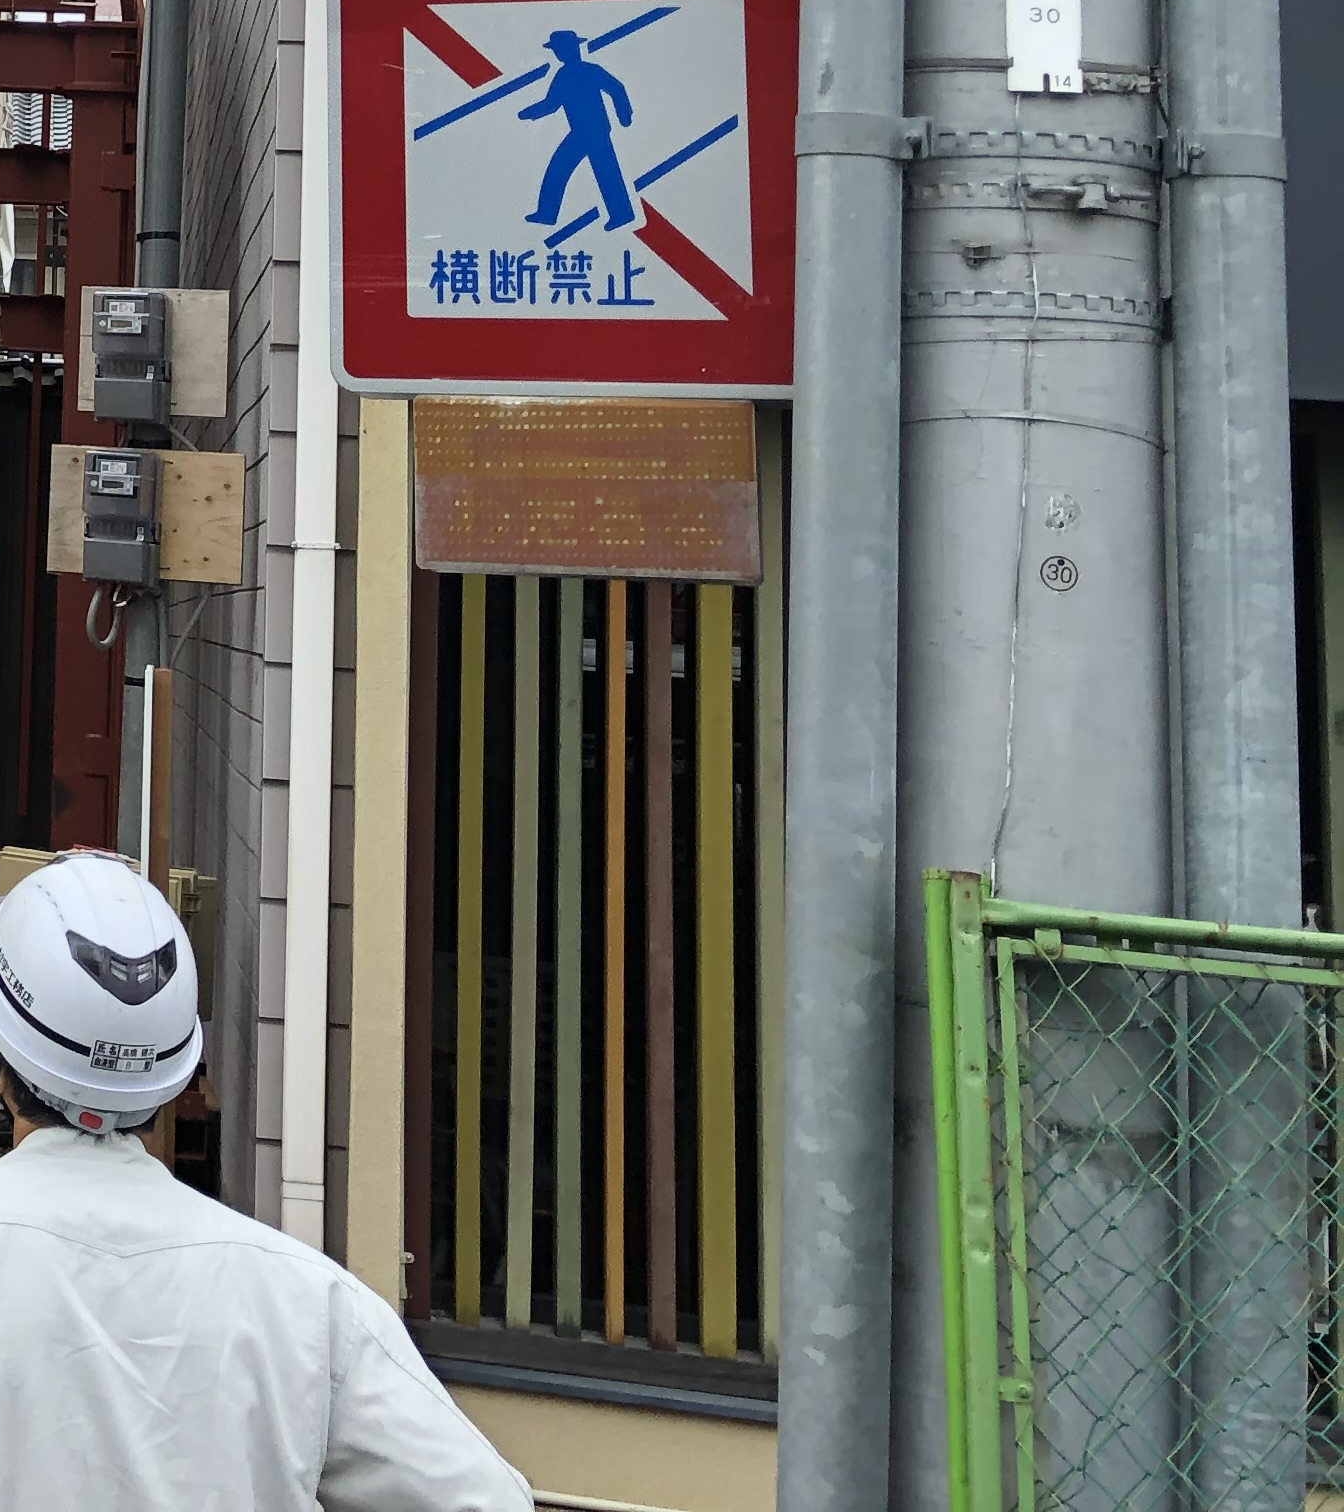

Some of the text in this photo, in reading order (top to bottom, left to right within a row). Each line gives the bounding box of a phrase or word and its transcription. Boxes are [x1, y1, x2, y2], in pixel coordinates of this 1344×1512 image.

[1030, 7, 1060, 23] 30
[1054, 76, 1072, 88] 14
[428, 249, 655, 305] 横断禁止
